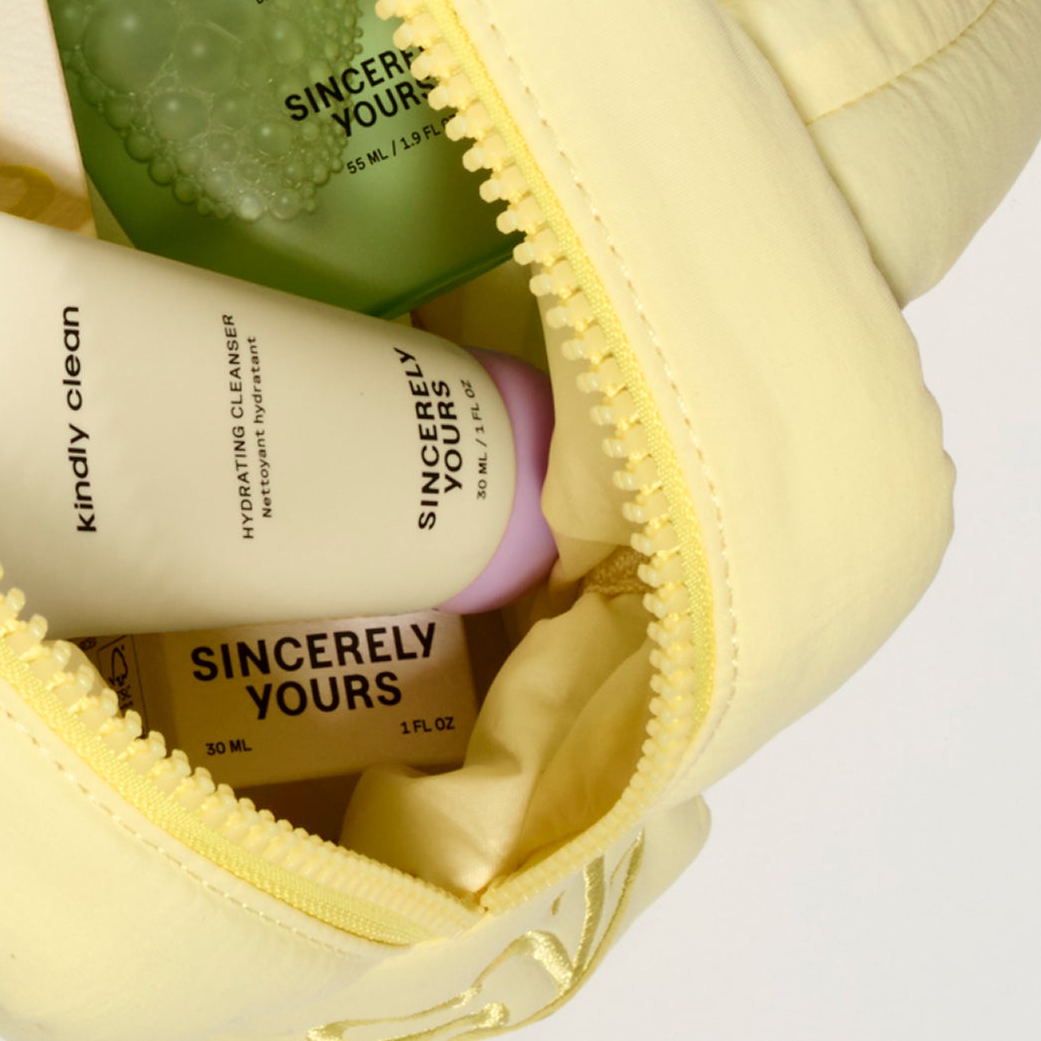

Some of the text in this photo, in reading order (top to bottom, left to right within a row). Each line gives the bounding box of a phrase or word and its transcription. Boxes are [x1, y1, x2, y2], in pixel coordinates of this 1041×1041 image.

[284, 45, 425, 122] SINCERE
[346, 156, 366, 175] 55
[366, 148, 389, 165] ML
[399, 131, 422, 150] 1.9
[421, 122, 443, 140] FL
[460, 379, 476, 399] OZ
[470, 402, 484, 422] FL
[62, 306, 97, 533] kindly clean
[221, 314, 254, 540] HYDRATING CLEANSER
[246, 337, 272, 519] Nettoyant hydratant
[393, 347, 441, 530] SINCERELY
[431, 380, 463, 494] YOURS
[474, 425, 485, 434] 1
[476, 478, 488, 500] 30
[478, 453, 488, 475] ML
[190, 622, 436, 682] SINCERELY
[245, 670, 402, 721] YOURS
[205, 738, 253, 757] 30 ML
[400, 716, 456, 735] 1 FL OZ
